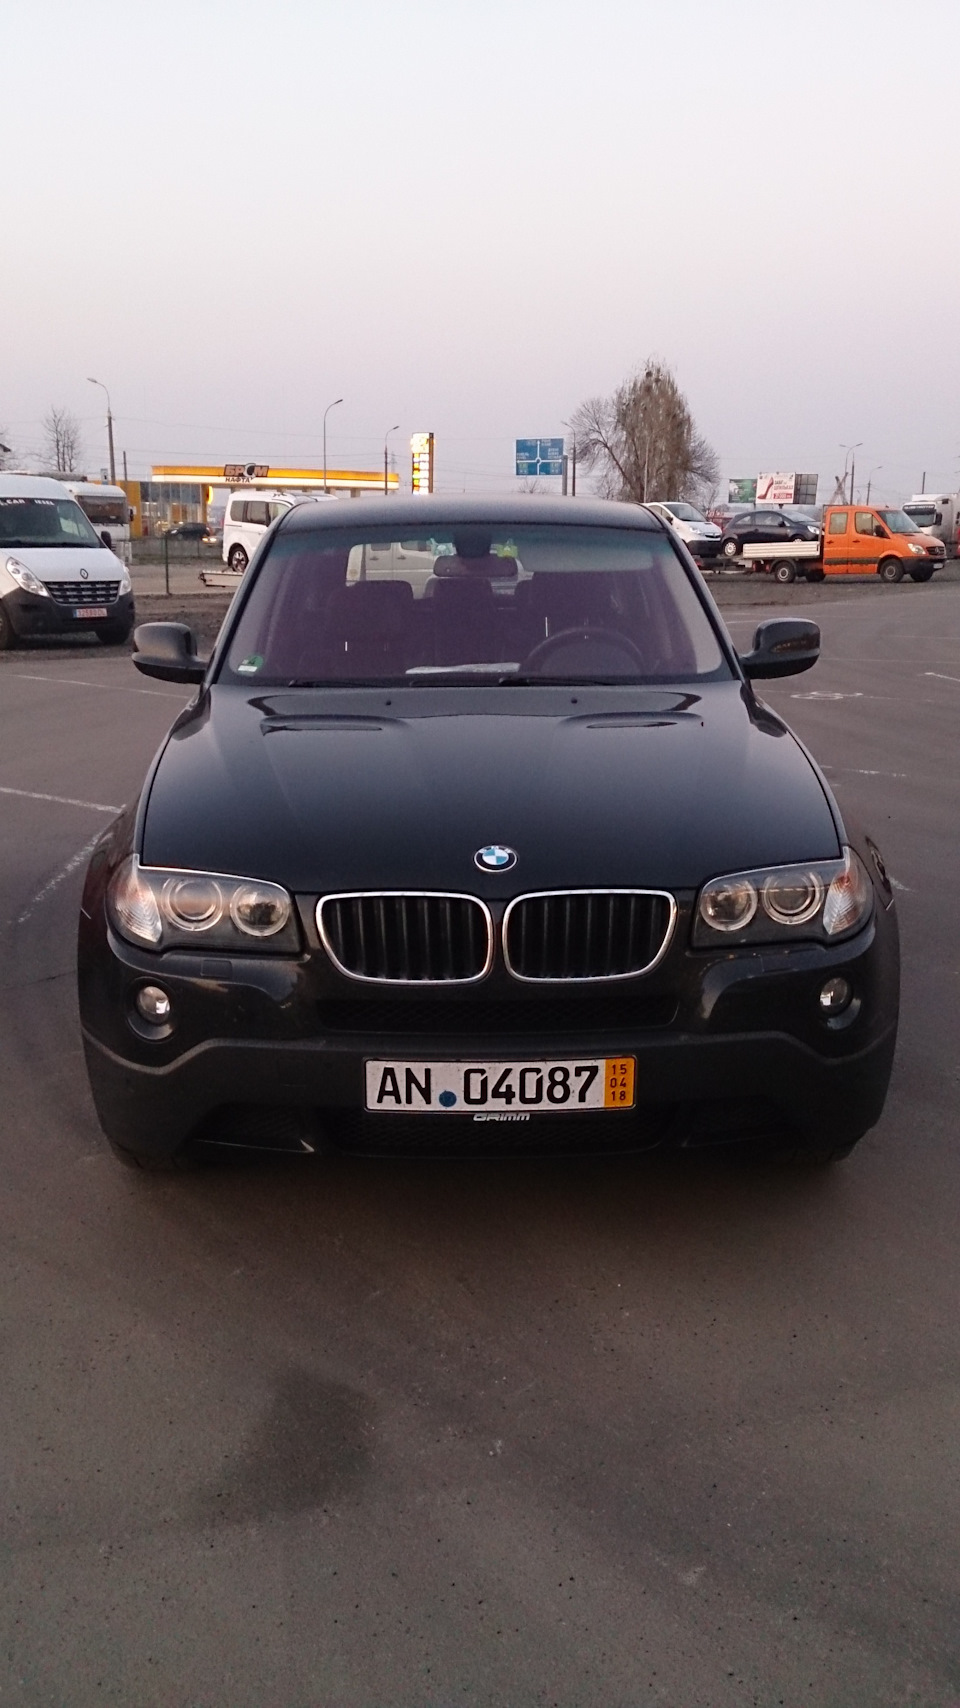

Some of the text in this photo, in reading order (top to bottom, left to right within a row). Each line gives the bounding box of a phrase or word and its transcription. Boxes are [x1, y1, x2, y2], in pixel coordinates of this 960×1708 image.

[611, 1064, 627, 1075] 15
[376, 1065, 599, 1105] AN 04087
[610, 1077, 627, 1088] 04
[611, 1090, 627, 1101] 18
